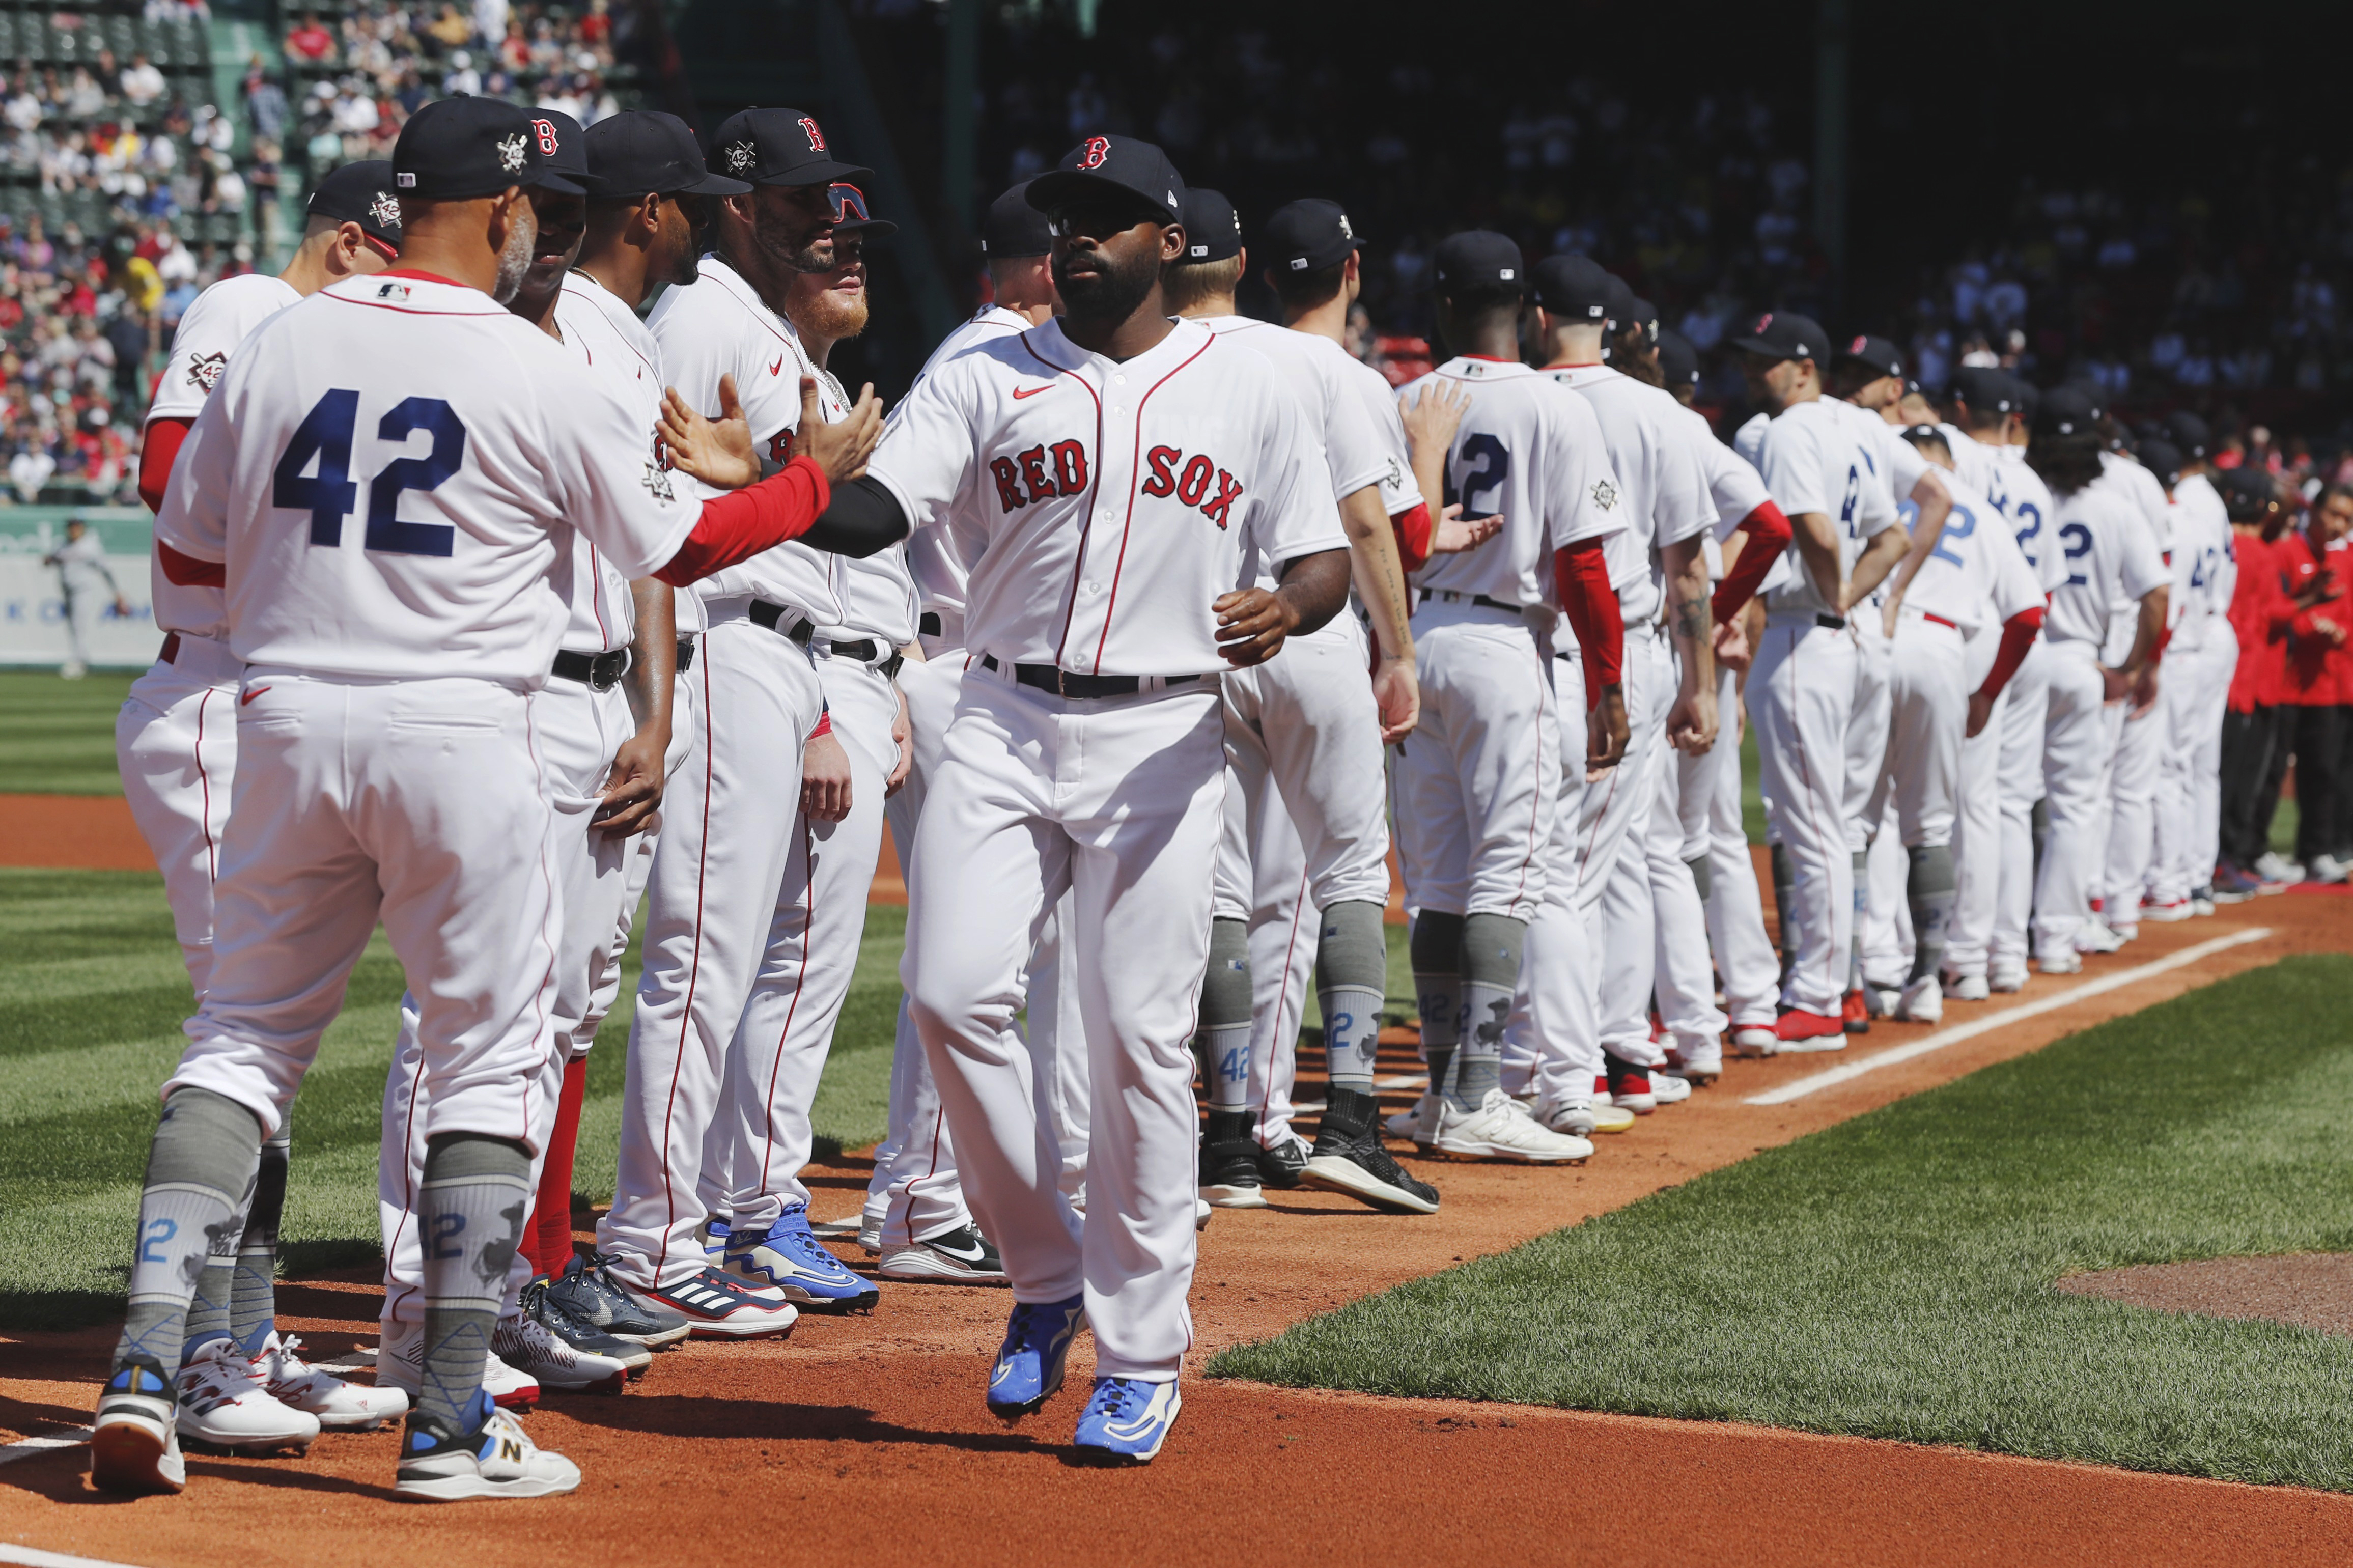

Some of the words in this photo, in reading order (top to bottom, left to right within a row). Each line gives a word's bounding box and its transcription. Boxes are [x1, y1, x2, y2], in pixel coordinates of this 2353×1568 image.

[530, 119, 559, 157] B
[797, 118, 825, 152] B
[733, 153, 746, 163] 42
[1076, 136, 1111, 170] B
[382, 204, 400, 217] 42
[273, 388, 466, 556] 42
[989, 439, 1089, 514] RED
[1141, 445, 1243, 531] SOX
[1219, 1046, 1249, 1081] 42
[734, 1229, 753, 1245] 42
[501, 1438, 522, 1464] N
